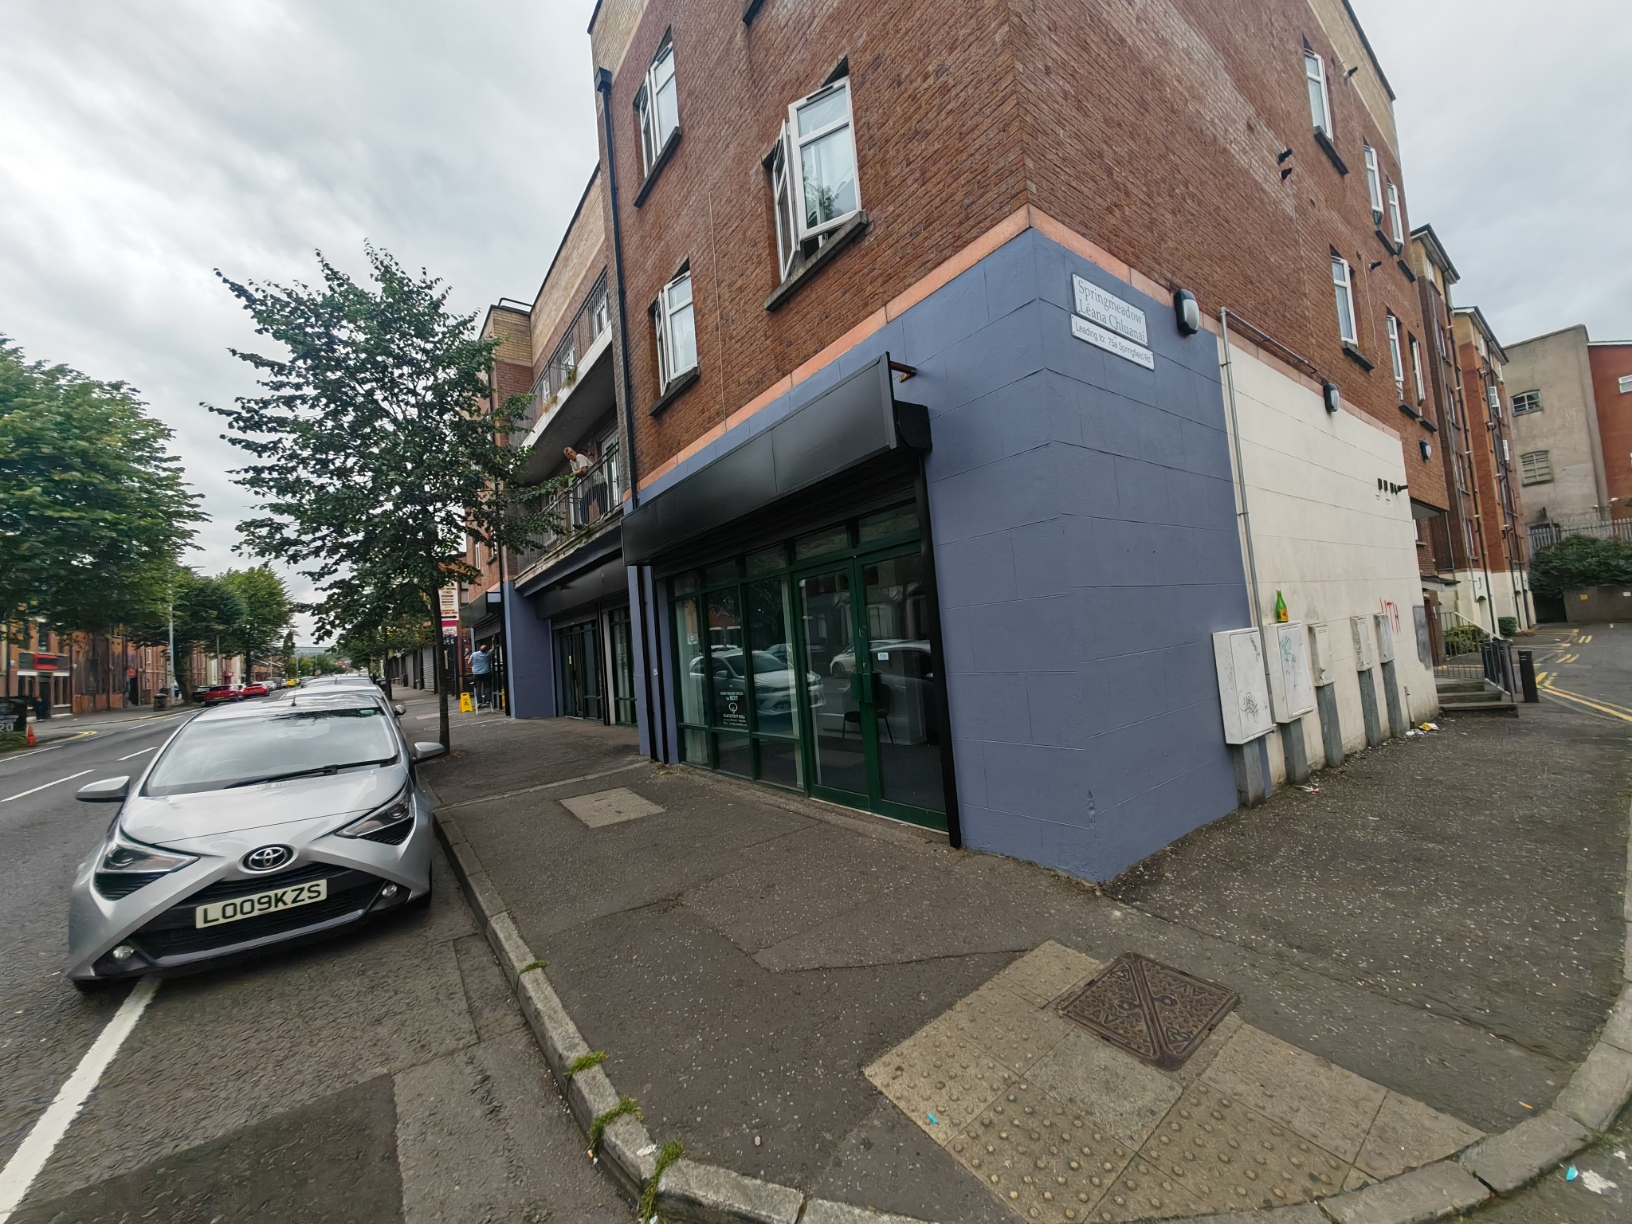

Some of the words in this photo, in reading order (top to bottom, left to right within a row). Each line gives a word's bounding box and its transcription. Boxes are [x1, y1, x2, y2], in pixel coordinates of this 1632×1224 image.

[1078, 279, 1142, 324] Springmeadow
[1079, 298, 1107, 324] Léana
[1075, 321, 1098, 342] Leading
[1118, 342, 1144, 361] Springfield
